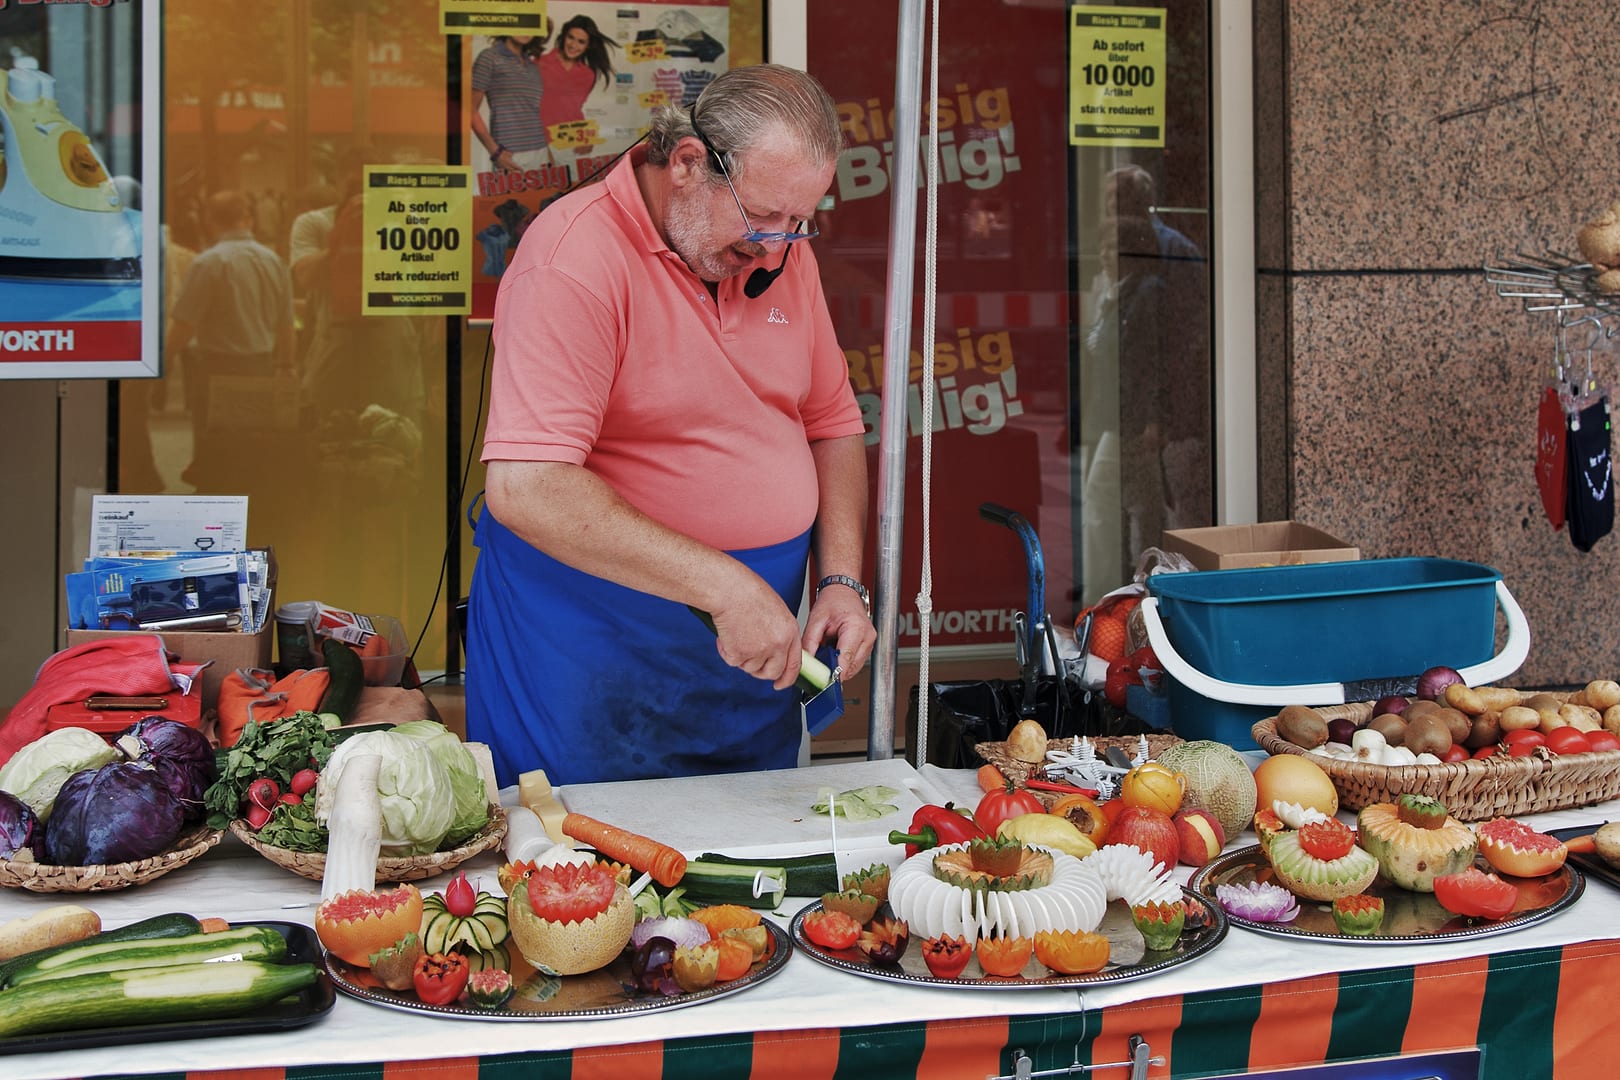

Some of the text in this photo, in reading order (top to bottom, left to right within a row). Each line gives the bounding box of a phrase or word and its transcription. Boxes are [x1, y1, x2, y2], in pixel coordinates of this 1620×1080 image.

[1093, 40, 1145, 52] Ab sofort
[1082, 64, 1155, 87] 10 000
[1104, 88, 1133, 97] Artikel
[835, 83, 1012, 144] Risig
[1080, 104, 1154, 116] stark reduziert!
[836, 121, 1023, 202] Blig!
[387, 175, 449, 187] Riesig Billig!
[477, 163, 567, 196] Riesig
[388, 201, 448, 213] Ab sofort
[406, 215, 430, 225] über
[376, 227, 460, 251] 10 000
[400, 253, 434, 262] Artikel
[374, 271, 459, 281] stark reduziert!
[0, 329, 74, 351] ORTH
[855, 364, 1025, 447] Bllig!
